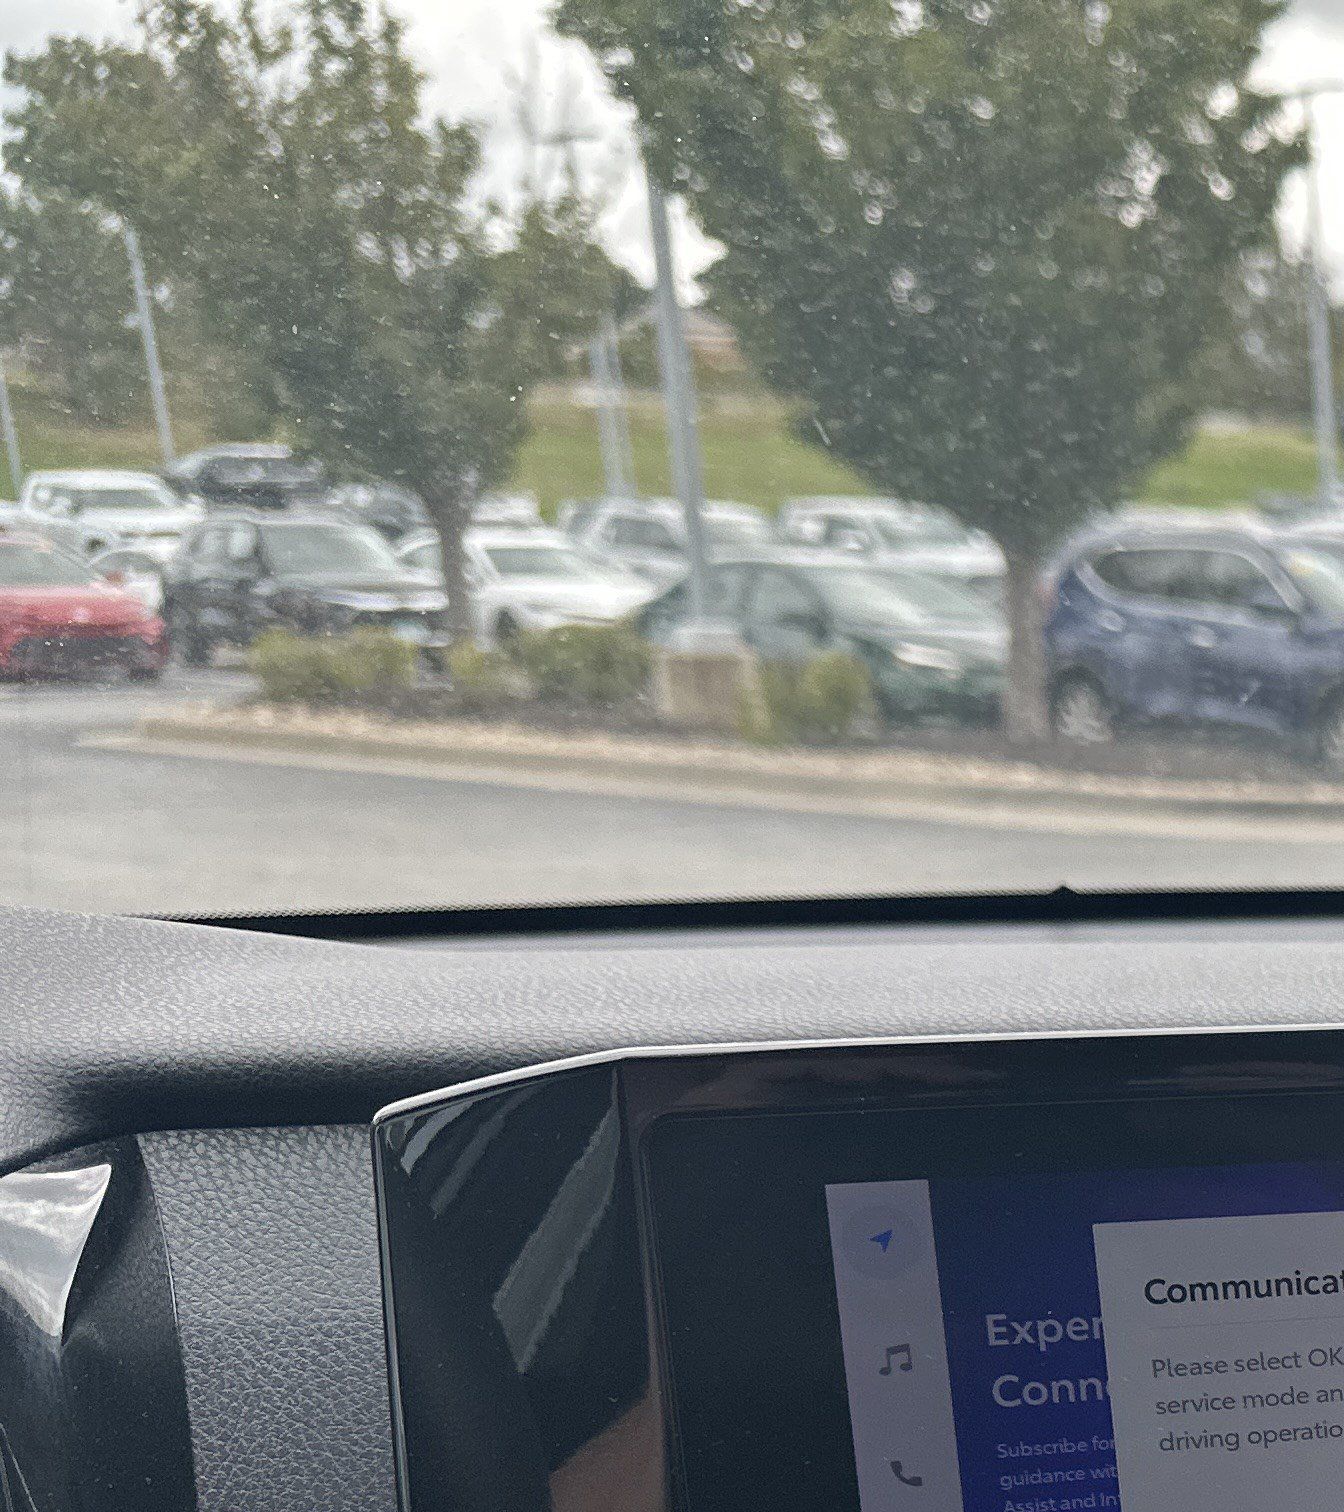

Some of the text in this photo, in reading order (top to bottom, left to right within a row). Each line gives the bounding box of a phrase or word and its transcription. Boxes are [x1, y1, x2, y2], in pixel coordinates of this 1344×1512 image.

[1151, 1358, 1229, 1378] Please
[1233, 1352, 1302, 1373] select
[1308, 1347, 1344, 1367] OK
[992, 1374, 1110, 1408] Conn
[1155, 1393, 1236, 1415] service
[1242, 1386, 1309, 1409] mode
[997, 1438, 1087, 1459] Subscribe
[1159, 1429, 1240, 1451] driving
[1000, 1469, 1085, 1491] guidance
[1060, 1494, 1096, 1512] and
[1100, 1492, 1122, 1507] In
